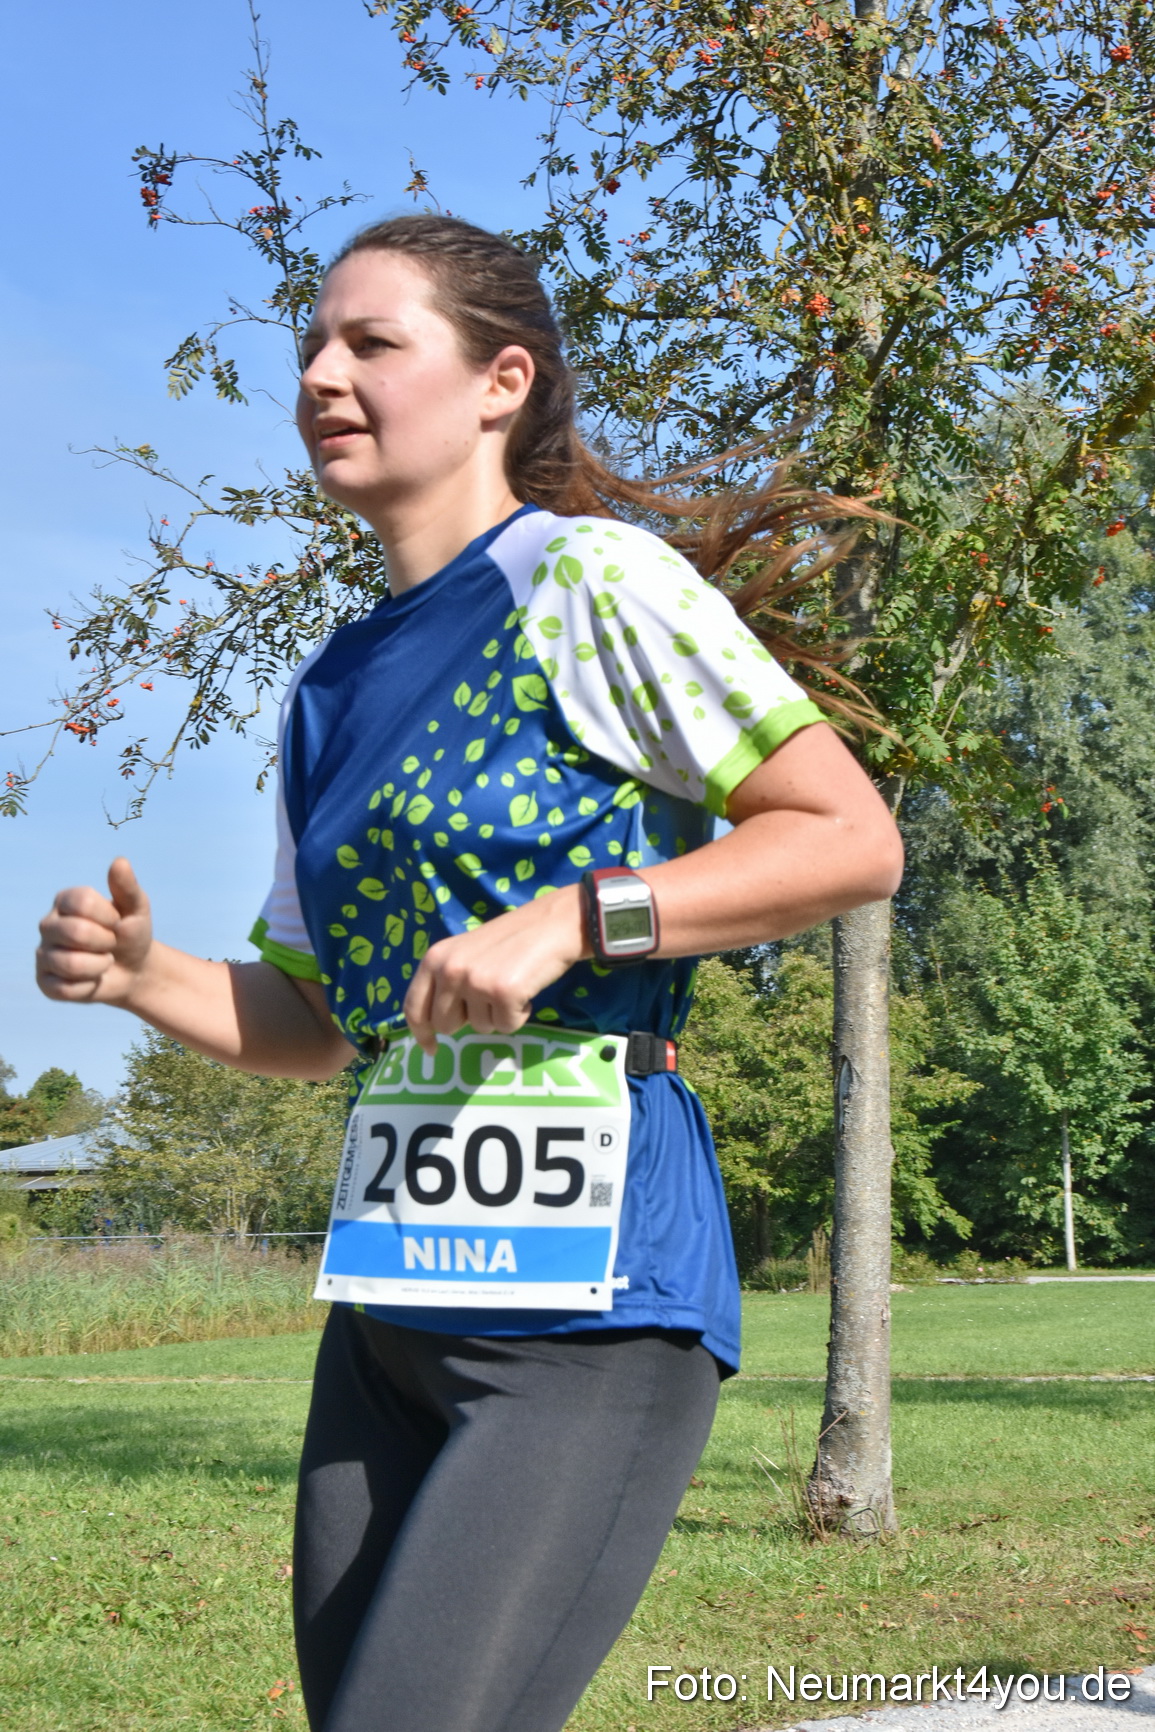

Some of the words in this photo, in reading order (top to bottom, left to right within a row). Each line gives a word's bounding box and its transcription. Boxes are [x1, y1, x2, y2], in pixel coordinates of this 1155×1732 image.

[369, 1037, 598, 1095] BOCK
[600, 1132, 613, 1147] D
[363, 1122, 586, 1208] 2605
[403, 1236, 518, 1273] NINA
